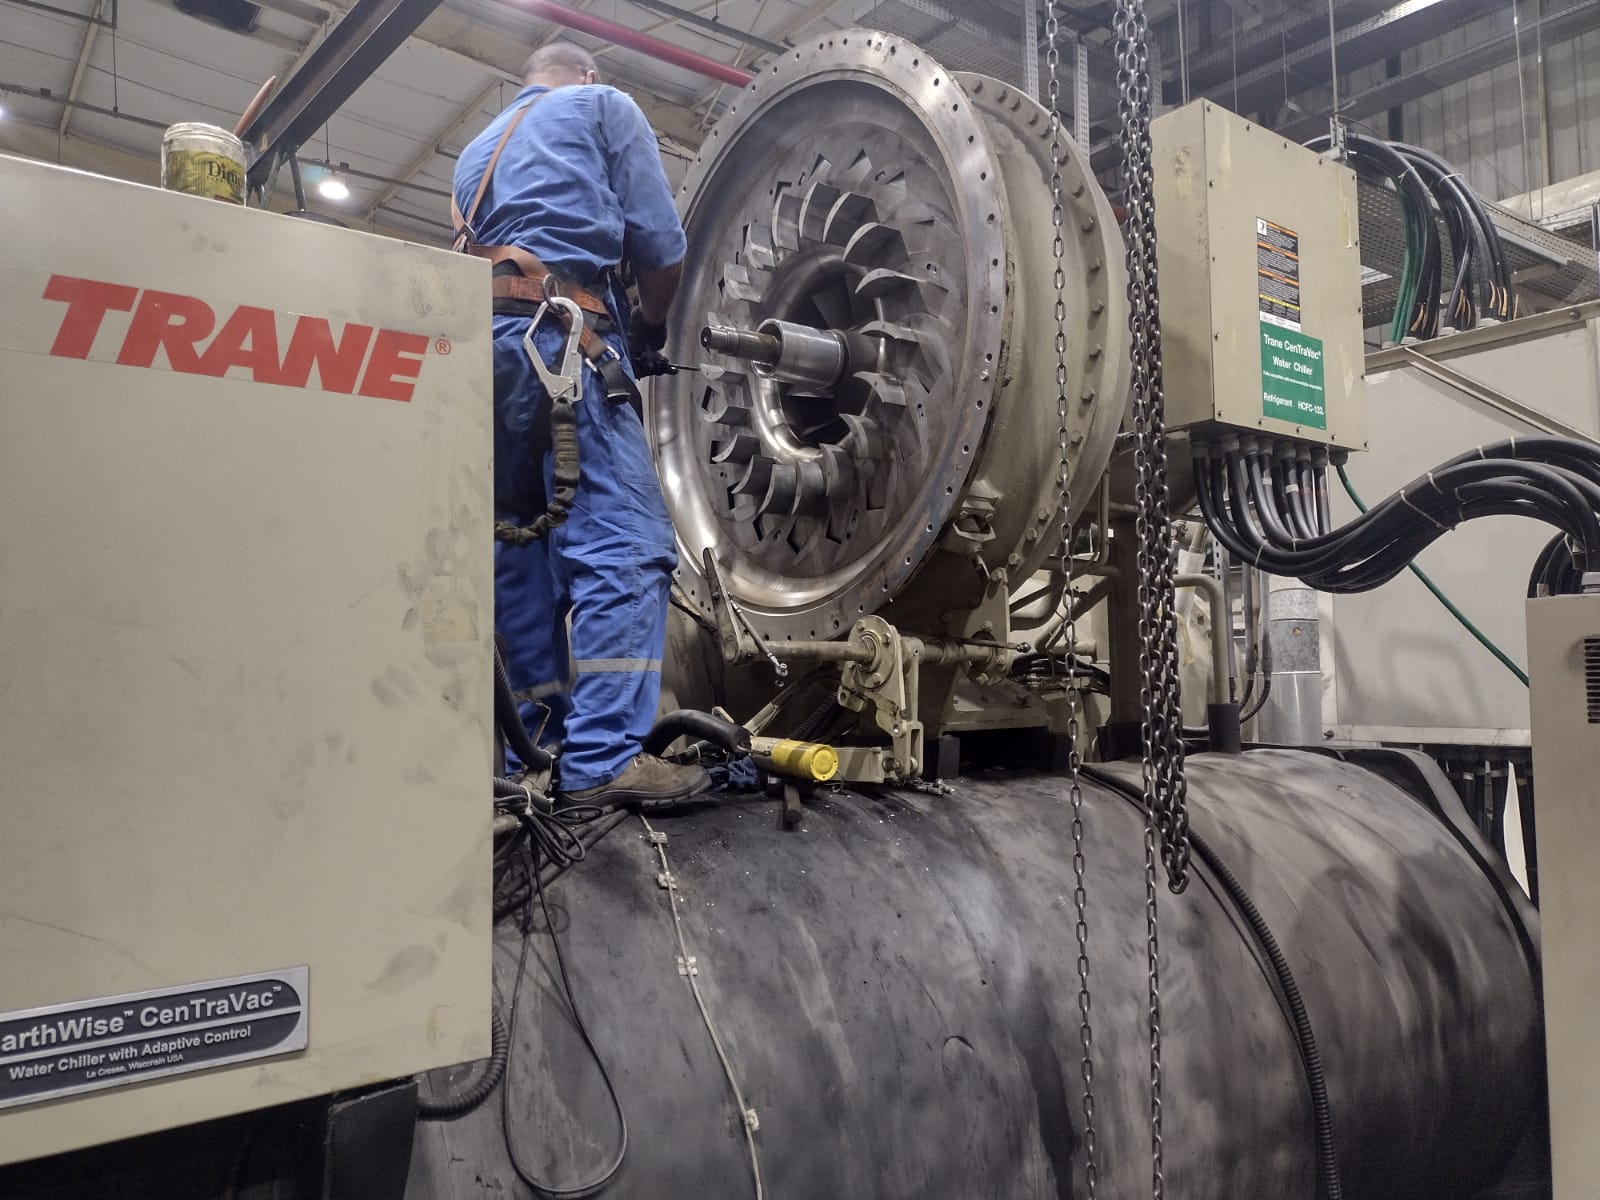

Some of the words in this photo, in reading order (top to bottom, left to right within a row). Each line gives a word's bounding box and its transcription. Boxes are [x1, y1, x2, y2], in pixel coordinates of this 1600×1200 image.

[207, 160, 241, 187] Dim
[1263, 333, 1283, 349] Trane
[1272, 355, 1291, 369] Water
[1293, 361, 1313, 376] Chiller
[1263, 391, 1293, 407] Refrigerant
[9, 1063, 54, 1080] Water
[58, 1053, 106, 1071] Chiller
[109, 1046, 138, 1062] with
[141, 1036, 200, 1057] Adaptive
[204, 1025, 251, 1044] Control
[128, 1057, 166, 1071] Wisconsin
[167, 1053, 184, 1063] USA
